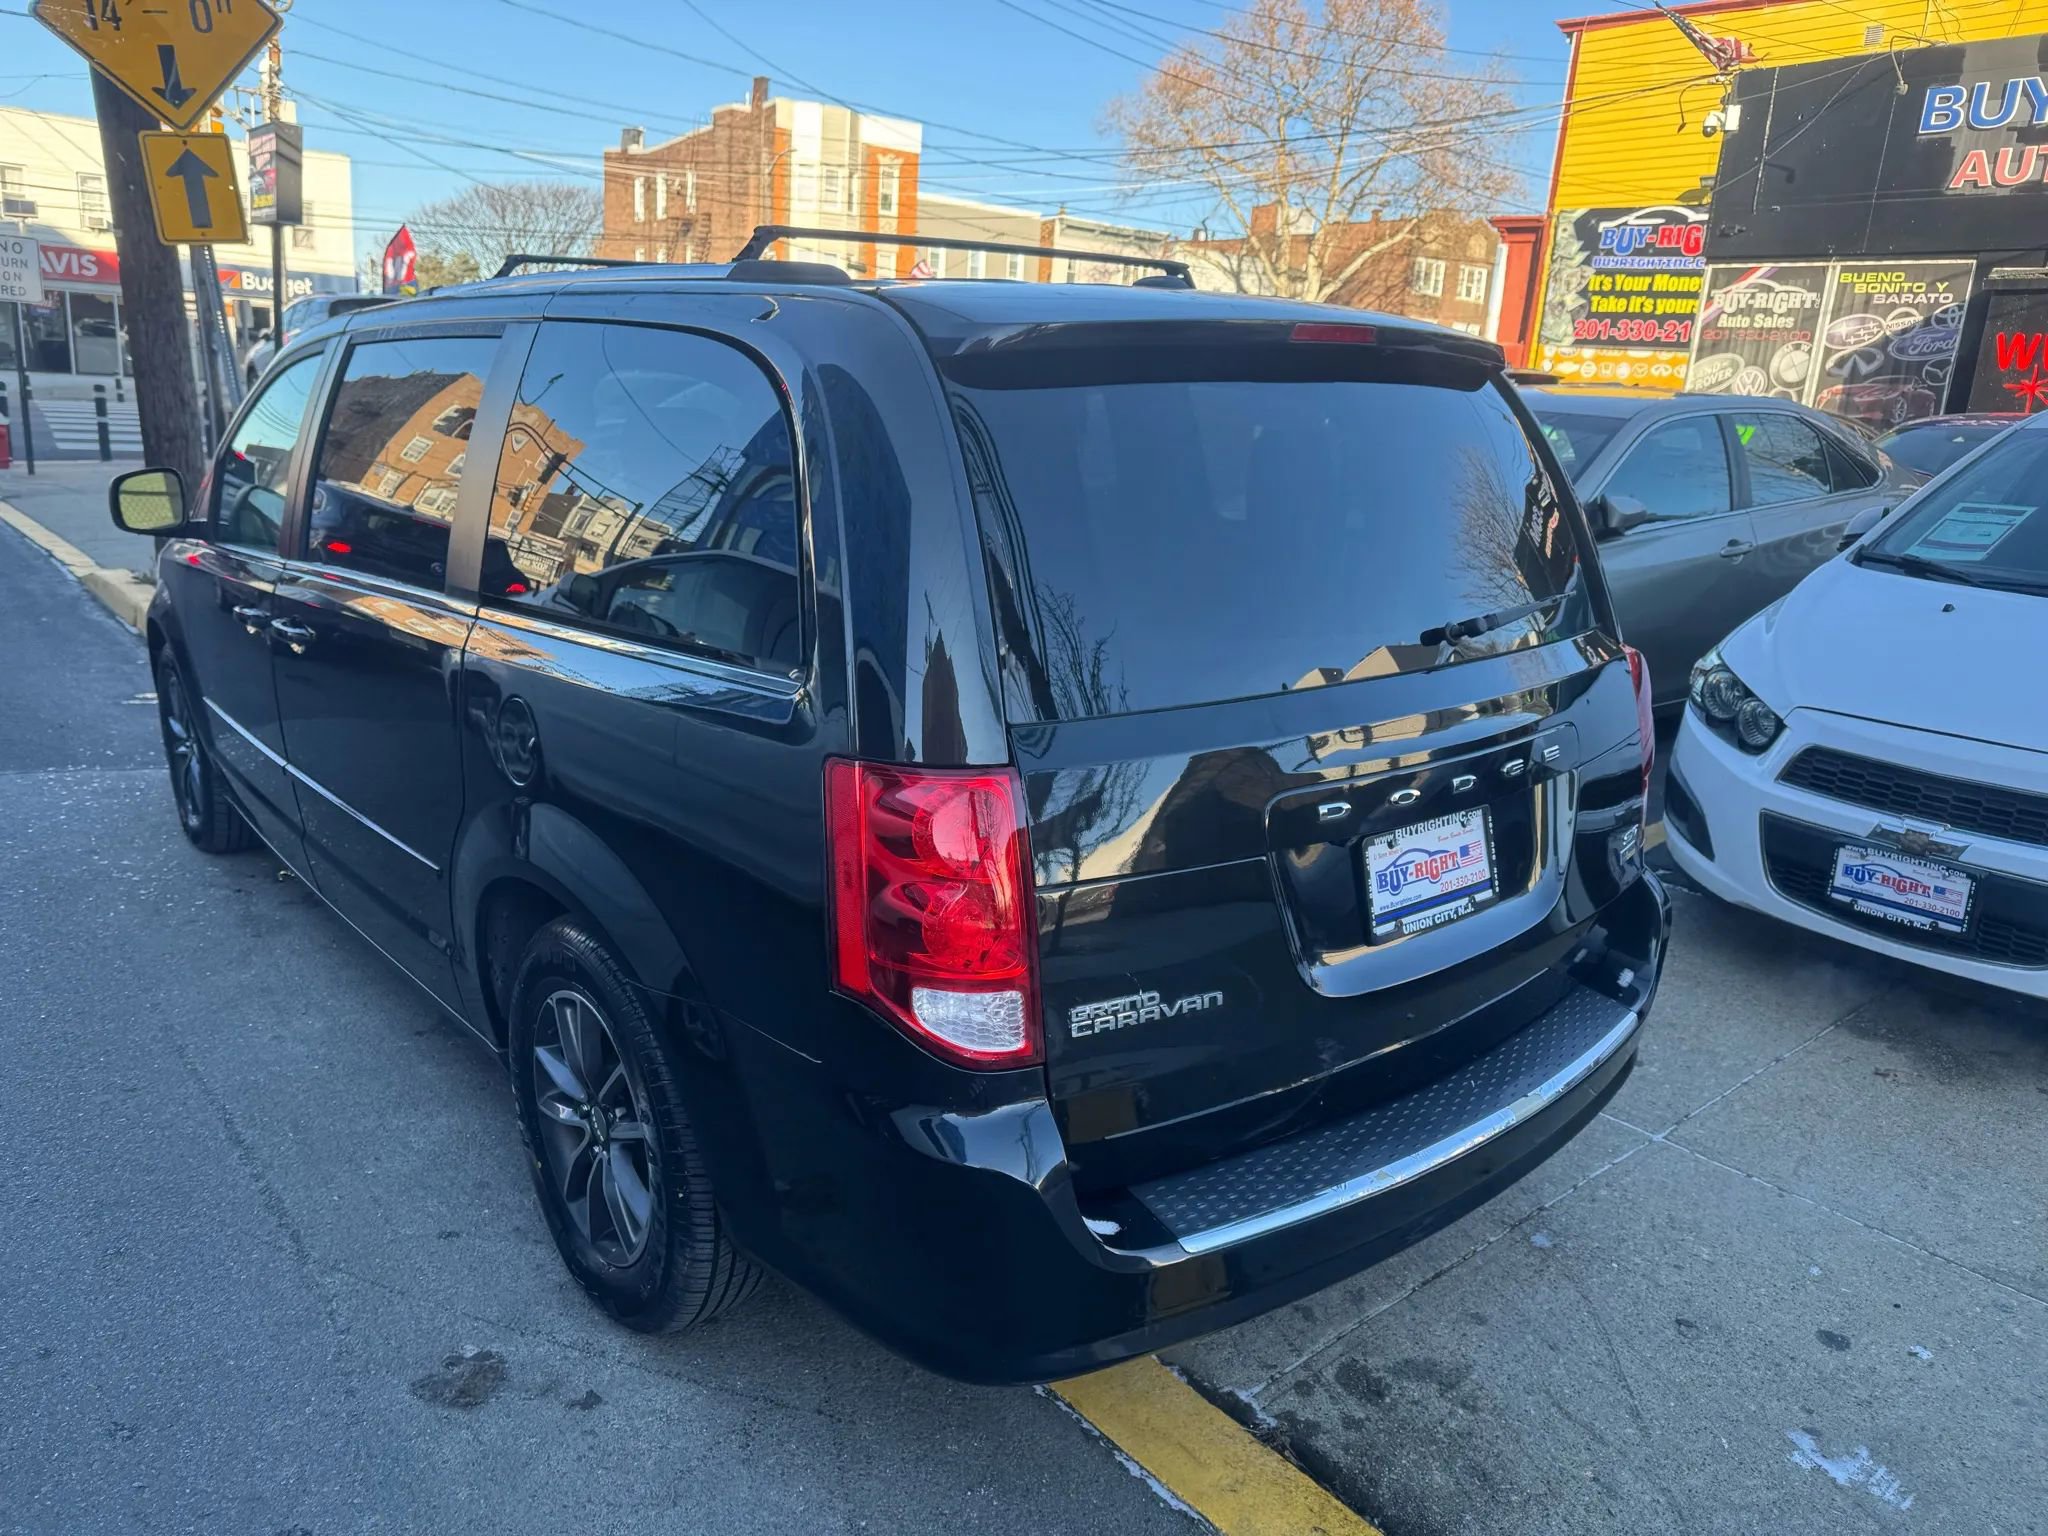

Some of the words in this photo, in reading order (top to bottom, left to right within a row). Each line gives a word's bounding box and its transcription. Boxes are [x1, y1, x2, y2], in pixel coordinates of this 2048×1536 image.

[1948, 144, 2048, 188] AU
[0, 241, 23, 254] NO
[1600, 225, 1704, 256] BUY-RIG
[0, 257, 28, 269] URN
[3, 271, 22, 281] ON
[1614, 274, 1652, 292] Your
[1840, 272, 1905, 283] BUENO
[1, 285, 26, 296] RED
[1854, 282, 1926, 293] BONITO
[1936, 281, 1949, 293] Y
[1590, 295, 1627, 313] Take
[1712, 291, 1818, 314] BUY-RIGHT
[1717, 314, 1751, 328] Auto
[1753, 313, 1795, 328] Sales
[1574, 319, 1692, 342] 201-330-21
[1318, 745, 1561, 823] DODGE
[1377, 851, 1460, 895] BUY-RIGHT
[1440, 868, 1487, 892] 201-330-2100
[1843, 863, 1931, 895] BUY-RIGHT
[1854, 905, 1885, 918] UNION
[1904, 896, 1961, 918] 201-330-2100
[1402, 917, 1434, 934] UNION
[1071, 991, 1223, 1038] CARAVAN
